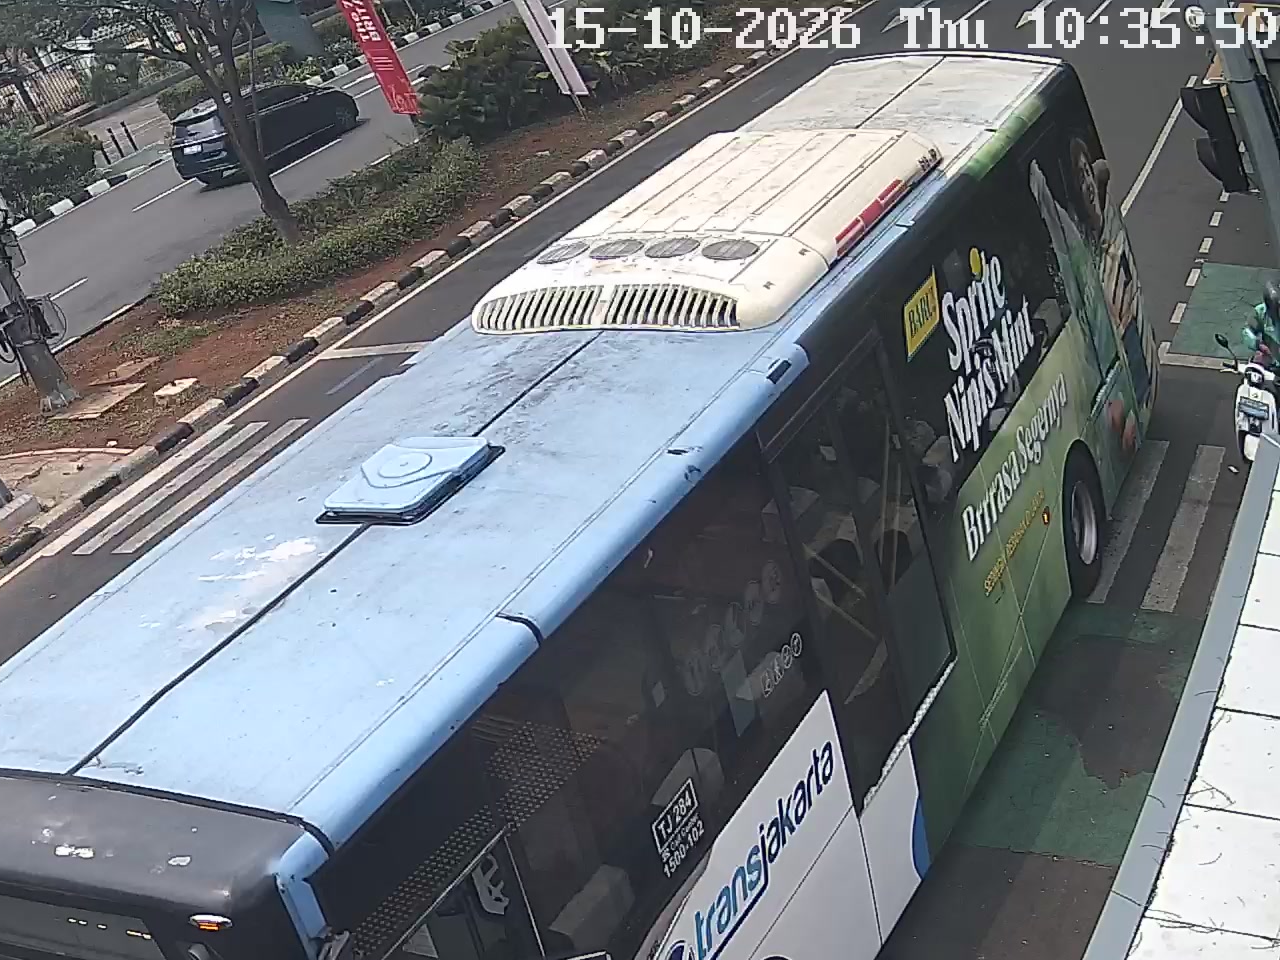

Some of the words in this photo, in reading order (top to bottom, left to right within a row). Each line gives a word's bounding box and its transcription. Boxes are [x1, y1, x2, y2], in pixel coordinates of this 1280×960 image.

[941, 247, 1006, 376] Sprite
[991, 293, 1035, 392] Mint
[658, 814, 673, 841] TJ
[672, 789, 693, 824] 284
